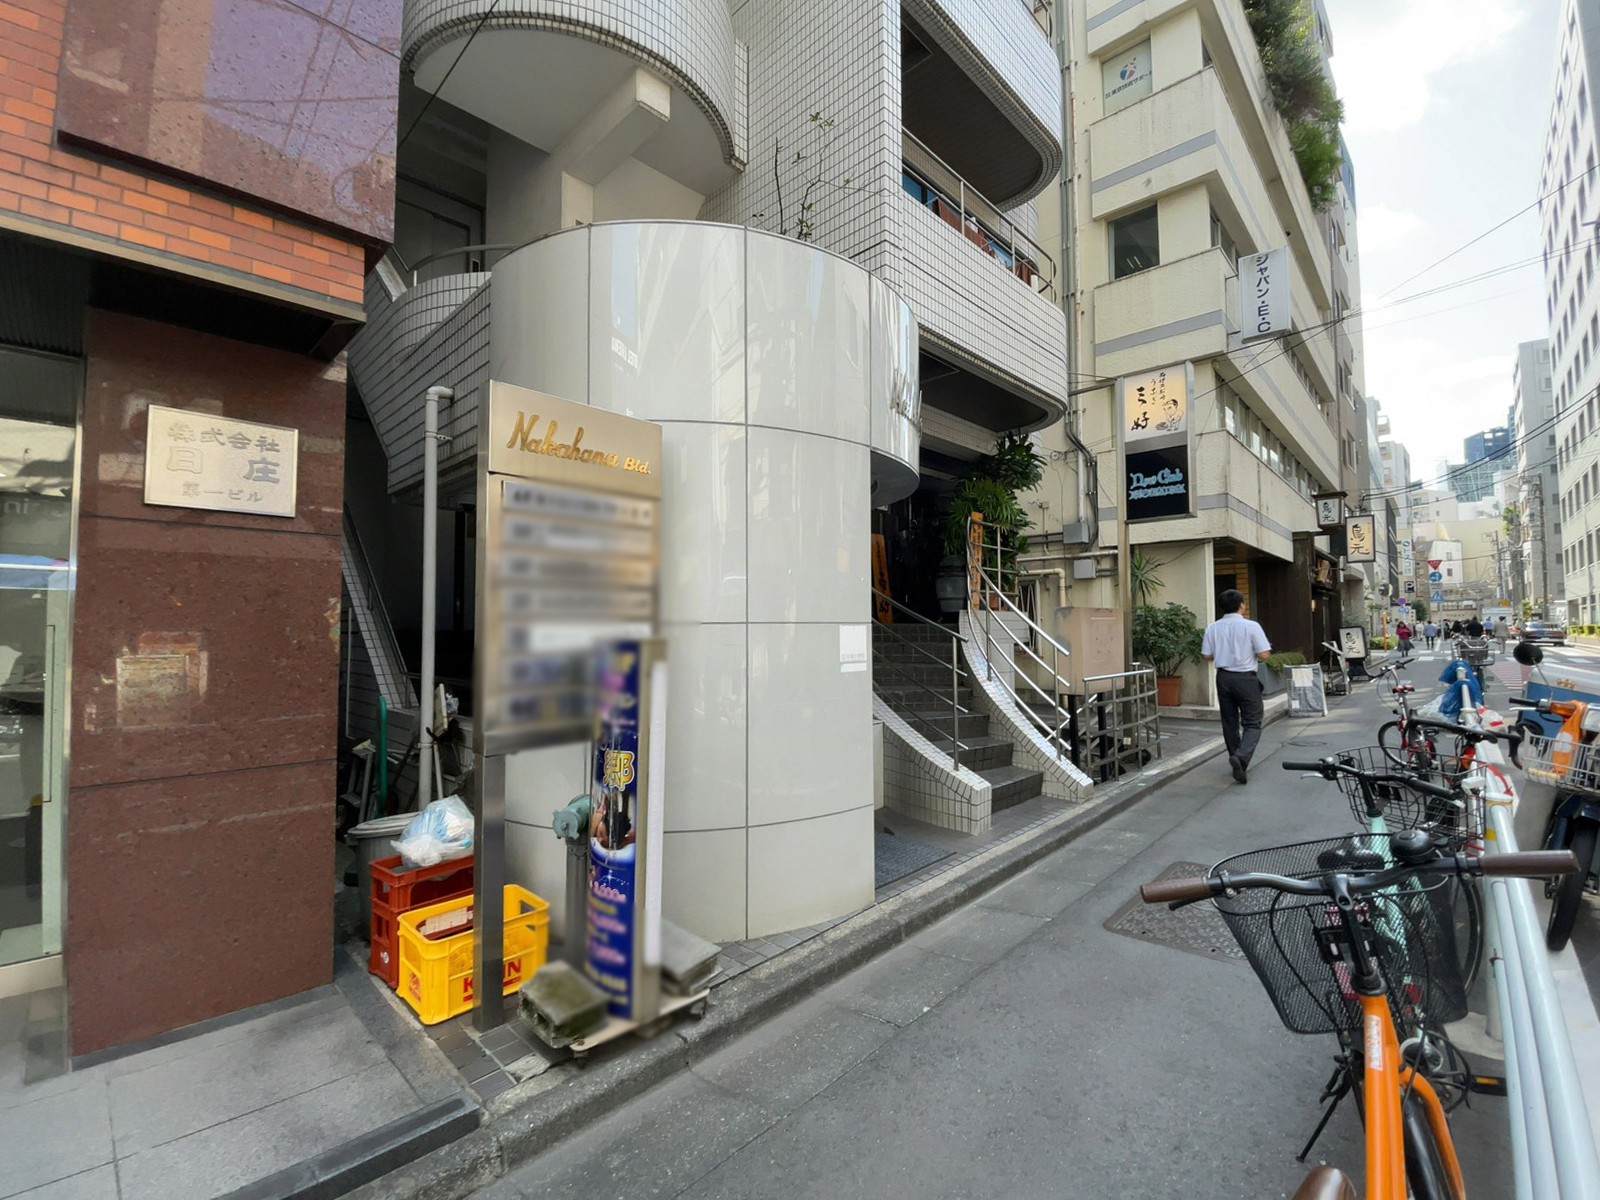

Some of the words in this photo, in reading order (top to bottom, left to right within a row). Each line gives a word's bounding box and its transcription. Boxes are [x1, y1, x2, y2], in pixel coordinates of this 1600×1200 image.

[168, 422, 281, 453] 株式会社
[506, 410, 619, 467] Nakahana
[1350, 523, 1371, 555] 鳥元
